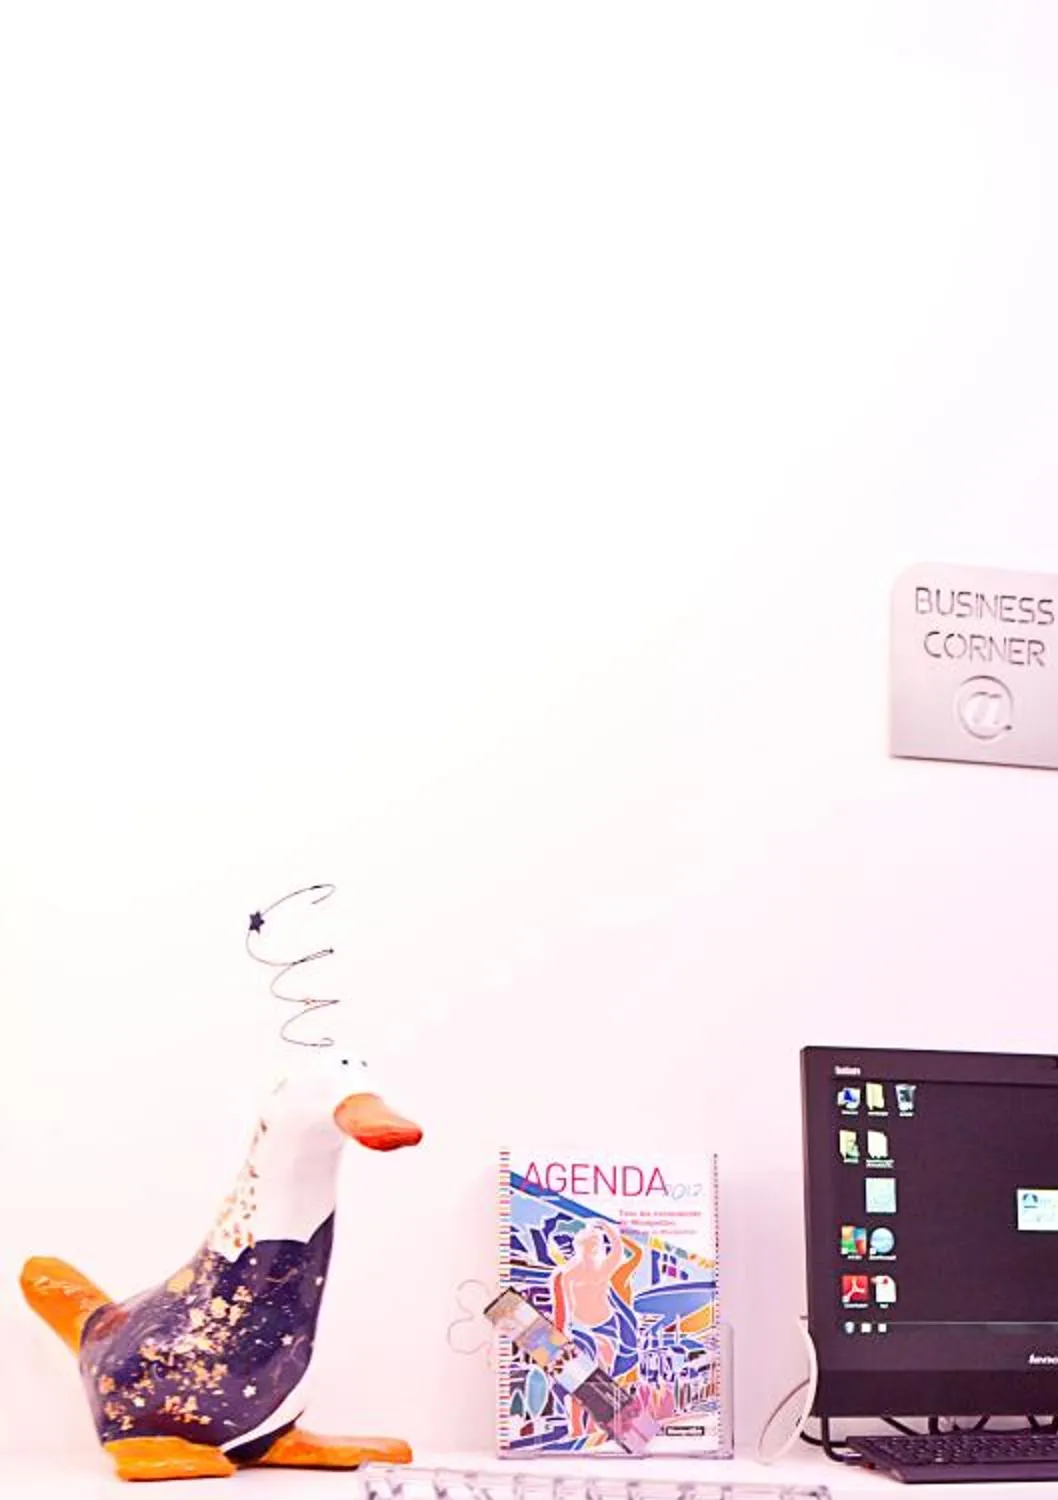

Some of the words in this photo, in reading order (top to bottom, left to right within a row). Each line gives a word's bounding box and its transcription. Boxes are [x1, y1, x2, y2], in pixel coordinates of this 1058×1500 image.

[915, 586, 1056, 626] BUSINESS
[923, 631, 1047, 667] CORNER
[520, 1162, 669, 1197] AGENDA
